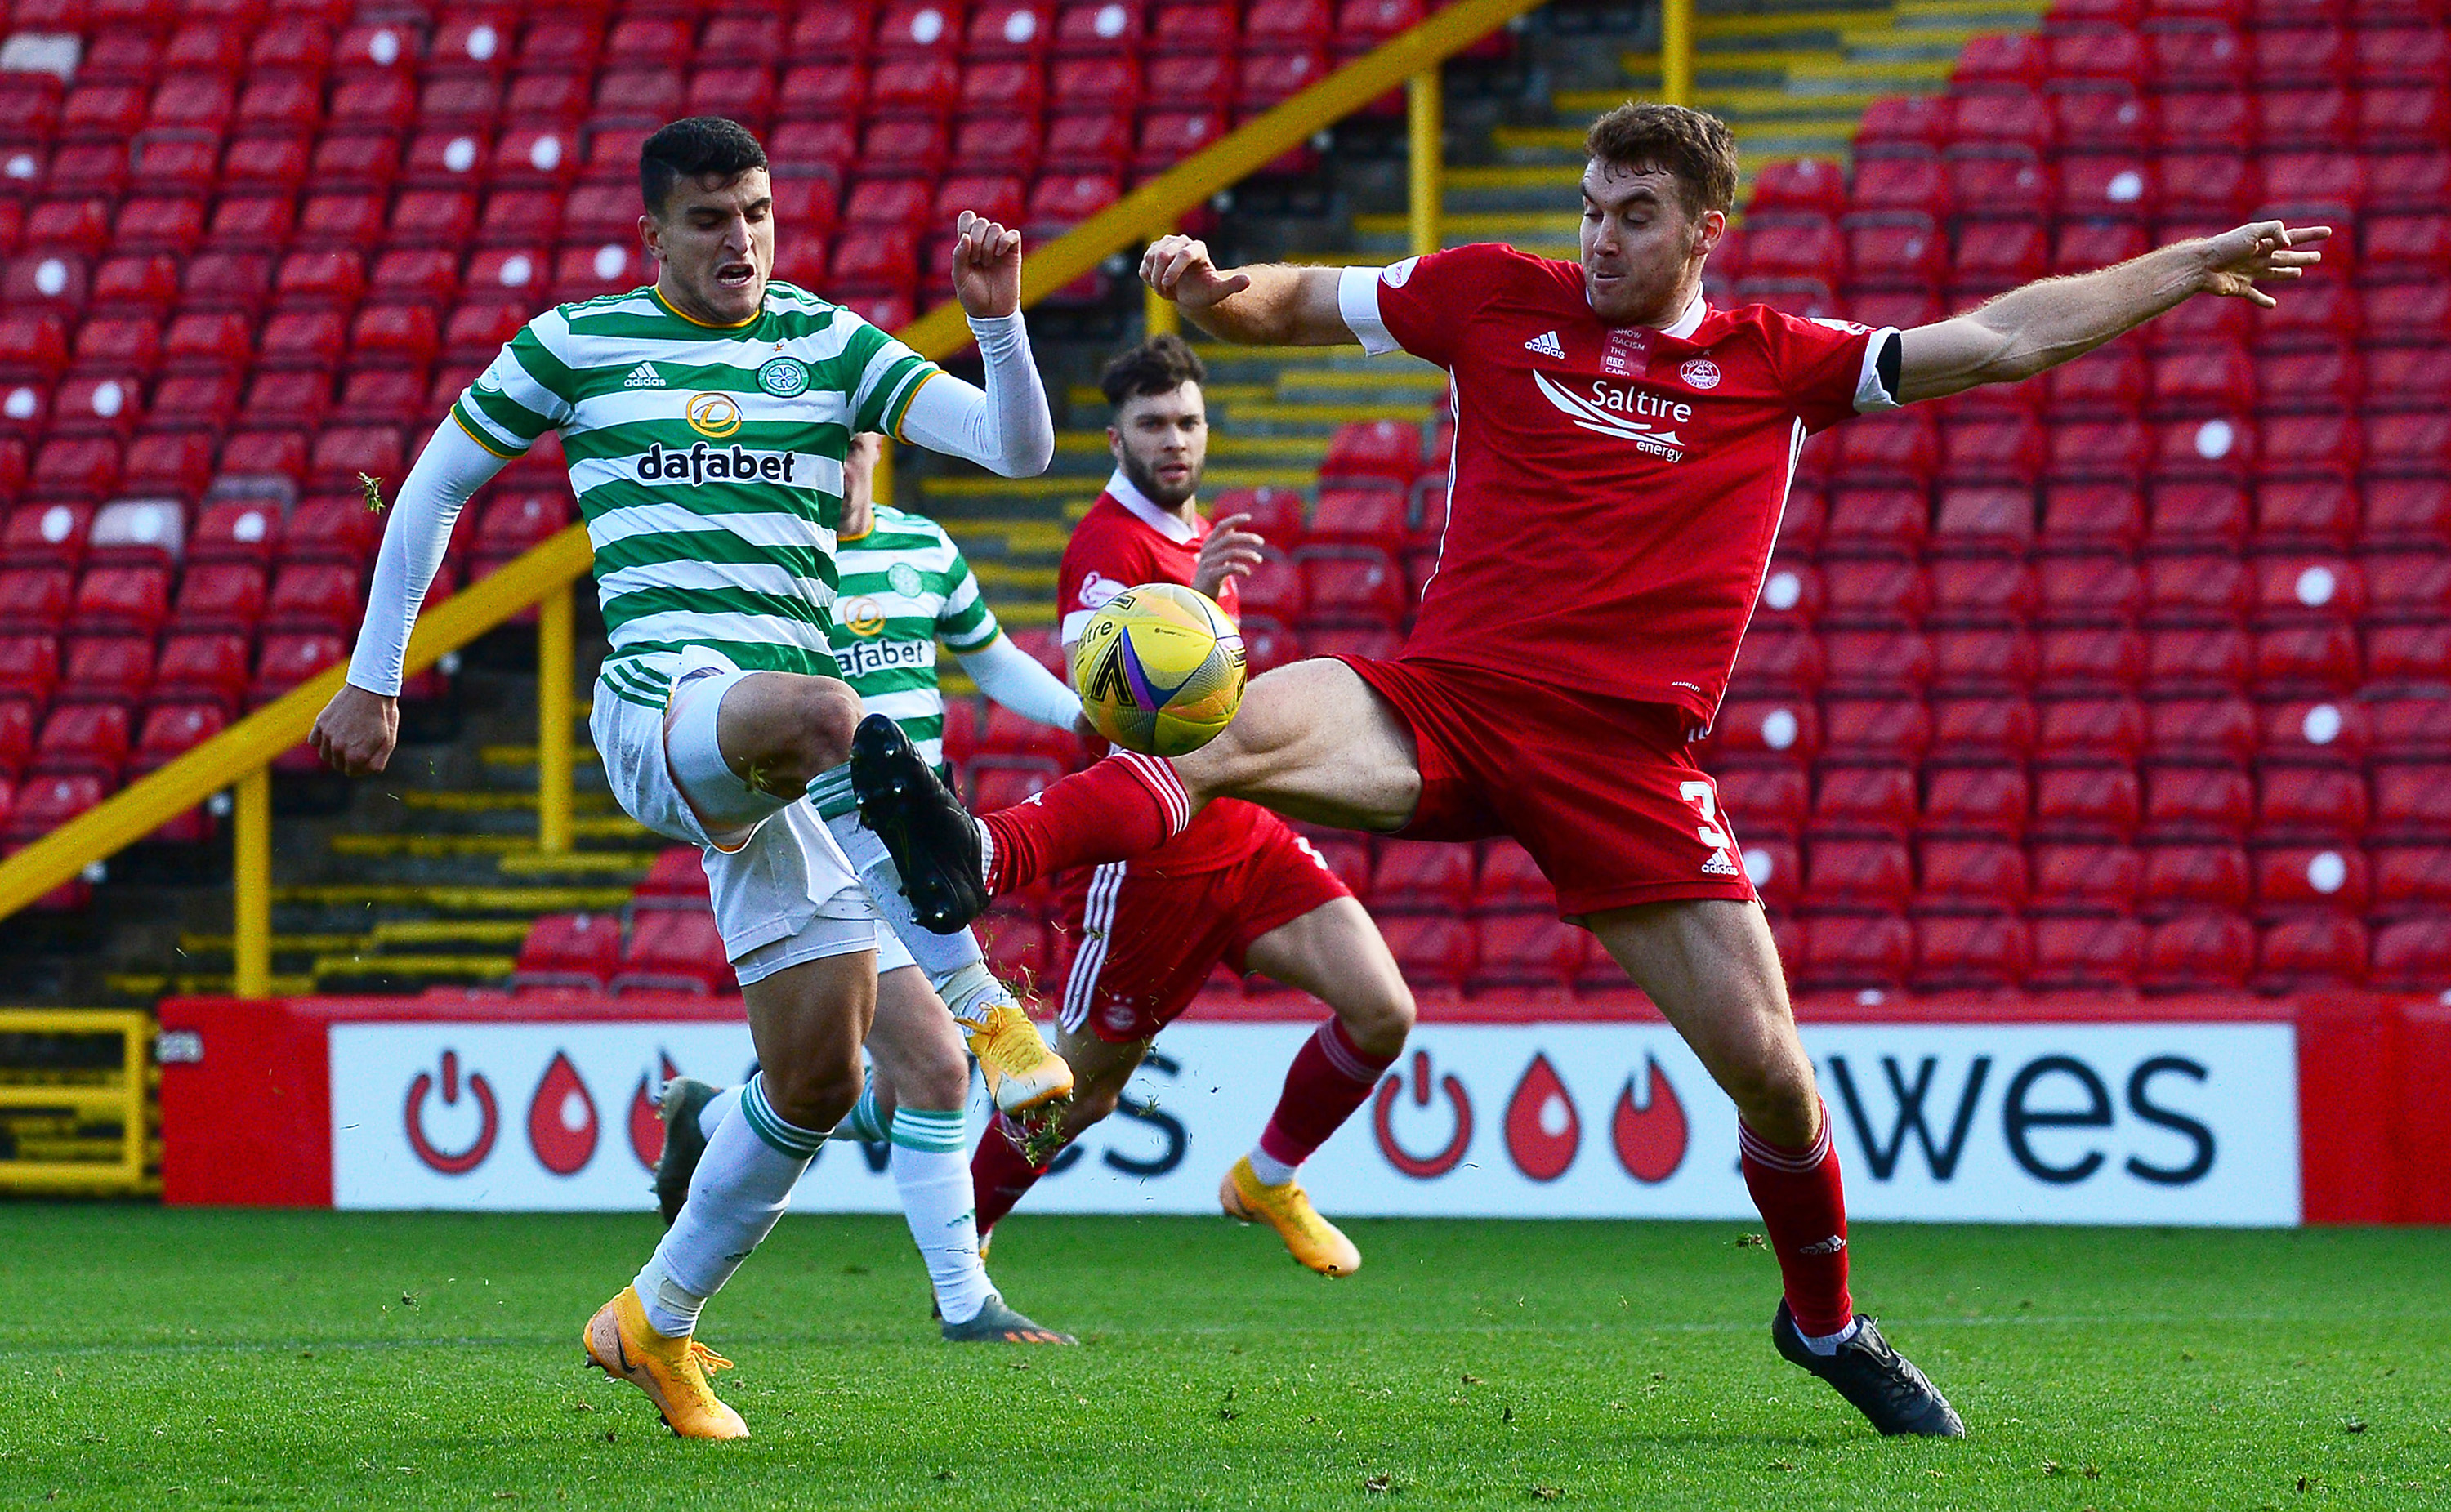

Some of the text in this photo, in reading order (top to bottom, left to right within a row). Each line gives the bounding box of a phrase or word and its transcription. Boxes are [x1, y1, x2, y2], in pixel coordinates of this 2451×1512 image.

[1614, 328, 1642, 339] SHOW
[1525, 341, 1565, 359] adidas
[1610, 346, 1627, 358] THE
[1612, 336, 1645, 351] RACISM
[1606, 356, 1625, 368] RED
[623, 377, 667, 387] adidas
[1590, 381, 1692, 423] Saltire
[1636, 441, 1683, 463] energy
[637, 443, 795, 485] dafabet
[835, 640, 923, 675] afabet
[1679, 781, 1730, 849] 3
[1701, 864, 1739, 876] adidas
[1736, 1054, 2217, 1186] wes
